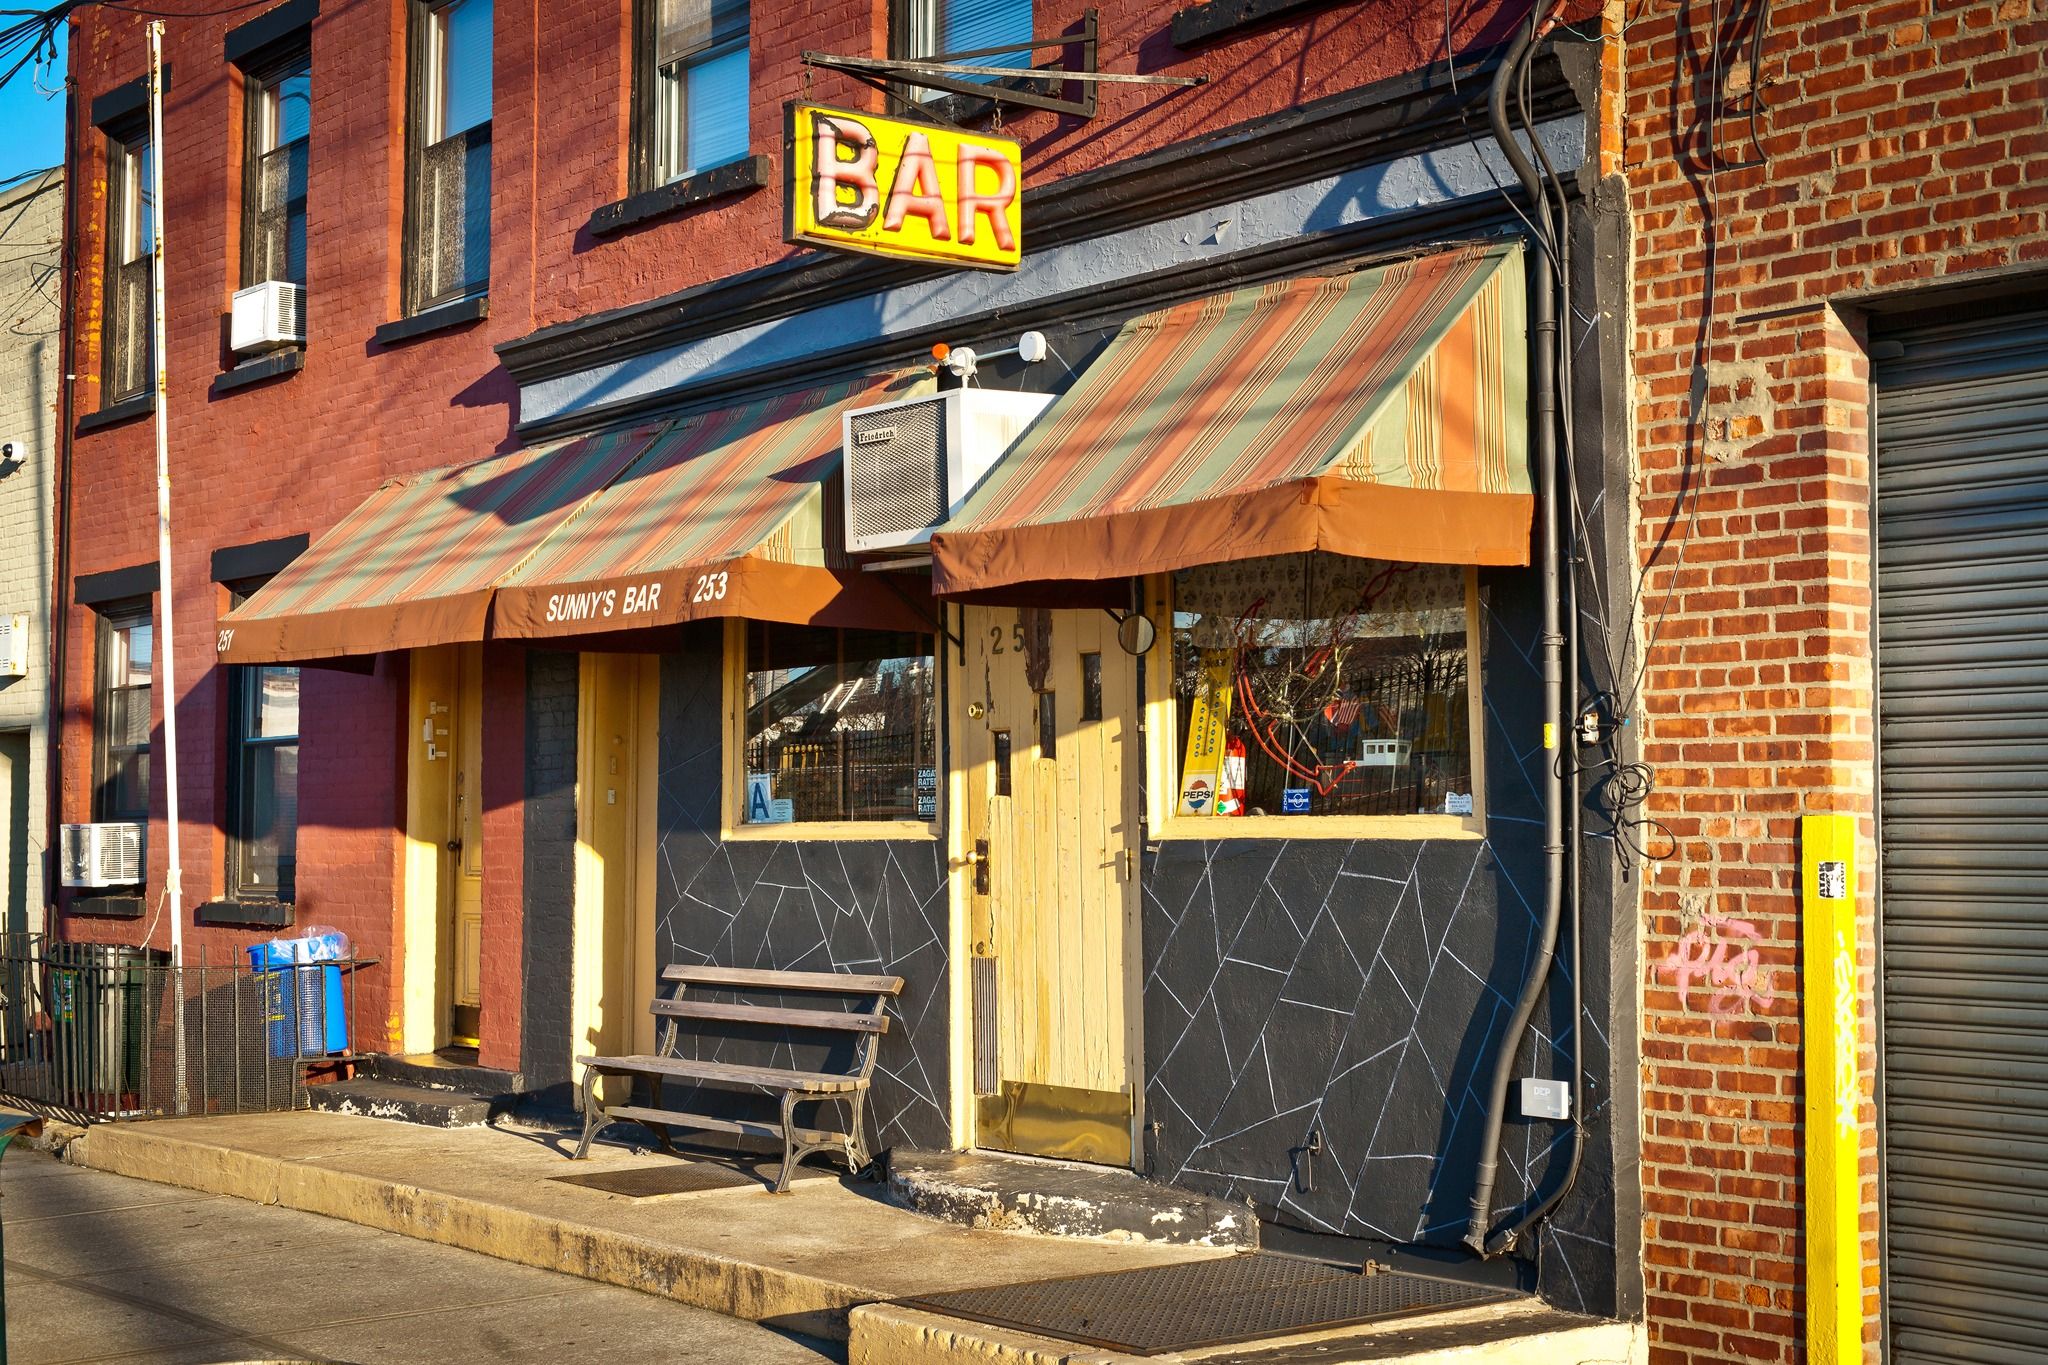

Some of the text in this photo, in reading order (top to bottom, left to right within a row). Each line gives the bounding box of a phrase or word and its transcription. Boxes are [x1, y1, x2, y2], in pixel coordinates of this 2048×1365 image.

[812, 111, 1016, 251] BAR
[860, 430, 894, 442] Friedrich
[693, 571, 728, 603] 253
[546, 583, 661, 622] SUNNY'S BAR
[217, 629, 235, 652] 251
[918, 769, 936, 778] ZAGA
[752, 783, 770, 819] A
[918, 796, 936, 804] ZAGA
[1182, 791, 1215, 800] PEPSI
